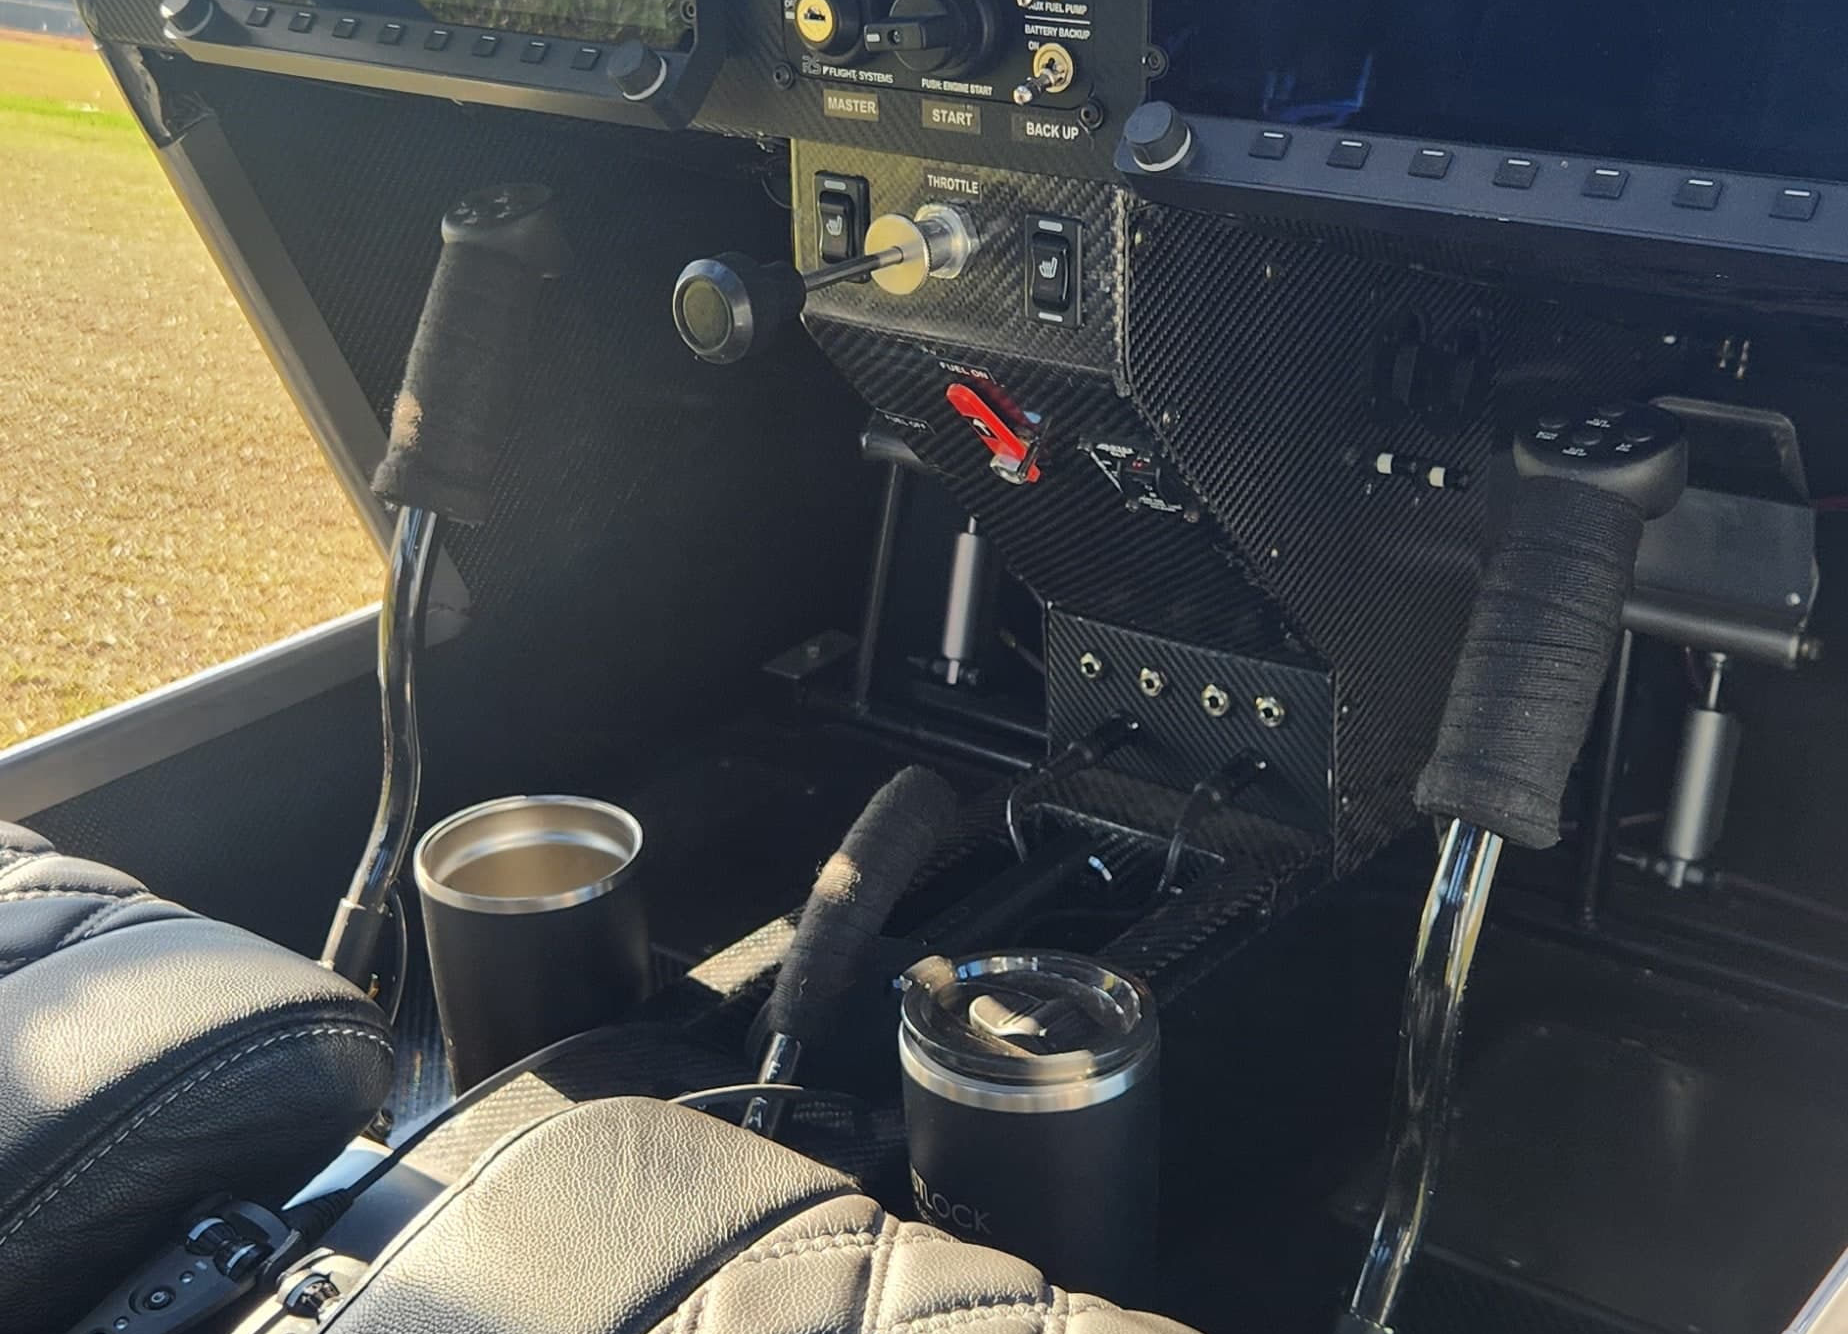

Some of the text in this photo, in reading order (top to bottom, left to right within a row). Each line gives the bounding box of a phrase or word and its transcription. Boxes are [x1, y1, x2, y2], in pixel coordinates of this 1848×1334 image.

[1045, 2, 1064, 13] FUEL
[1065, 4, 1088, 15] PUMP
[1025, 24, 1091, 40] BATTERY BACKUP
[1028, 41, 1040, 51] ON
[859, 70, 894, 84] SYSTEMS
[943, 80, 969, 94] ENGINE
[970, 84, 993, 96] START
[827, 97, 876, 114] MASTER
[932, 109, 973, 127] START
[1026, 122, 1079, 140] BACK UP
[927, 175, 979, 195] THROTTLE
[939, 361, 989, 380] FUEL ON
